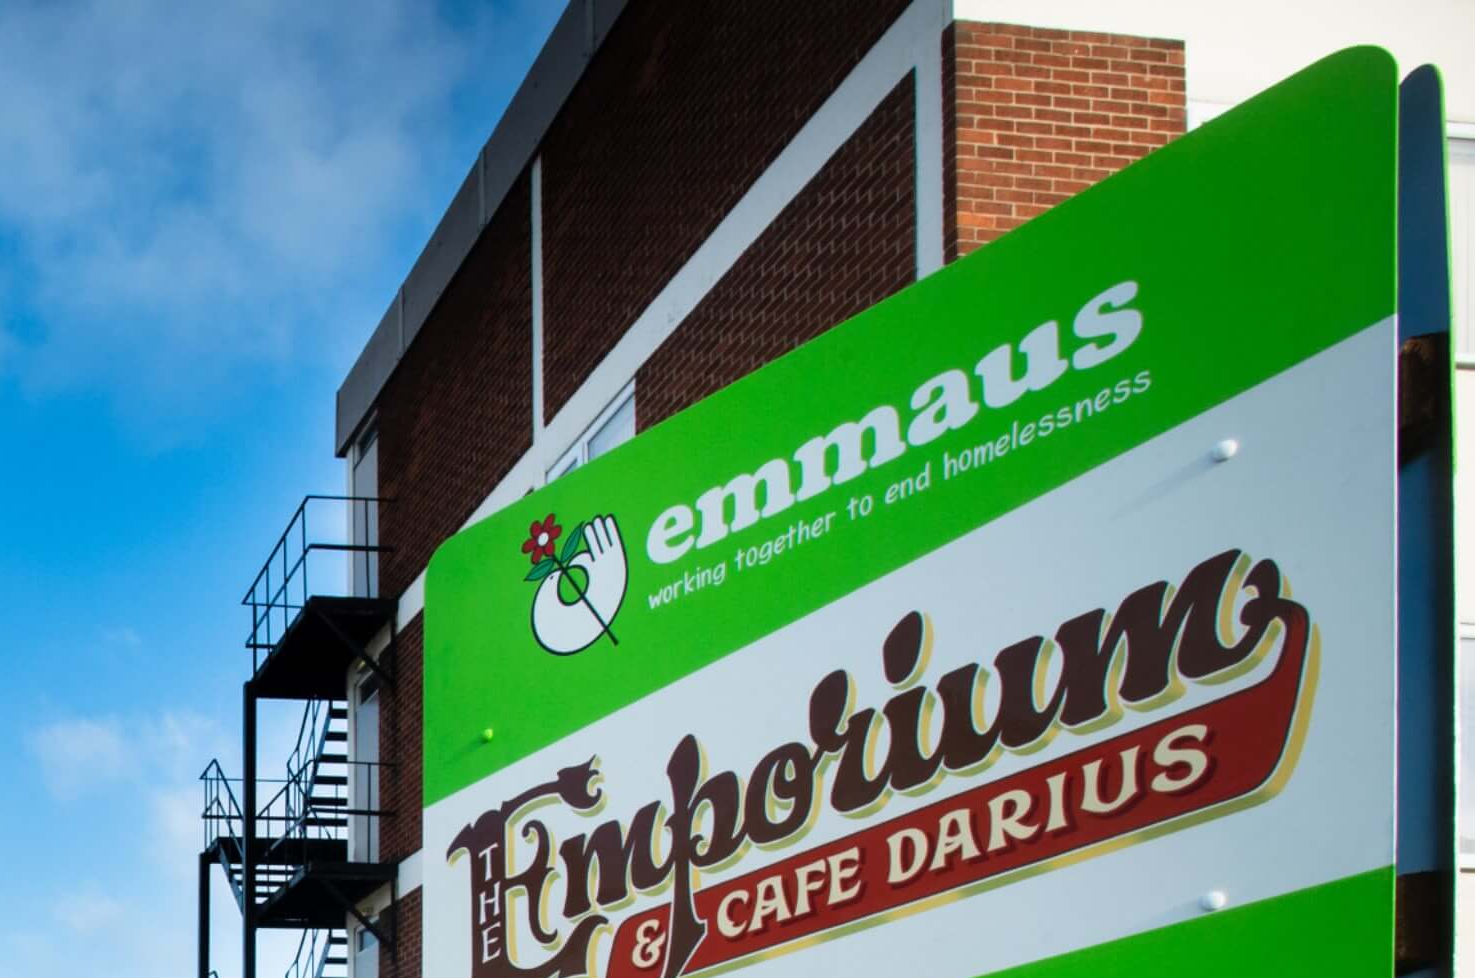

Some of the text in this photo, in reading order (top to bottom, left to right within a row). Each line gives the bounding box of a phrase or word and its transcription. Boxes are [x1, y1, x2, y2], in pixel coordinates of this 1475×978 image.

[646, 280, 1143, 565] emmaus
[647, 370, 1152, 610] working together to end homelessness
[478, 843, 502, 964] THE
[631, 723, 1209, 969] & CAFE DARIUS
